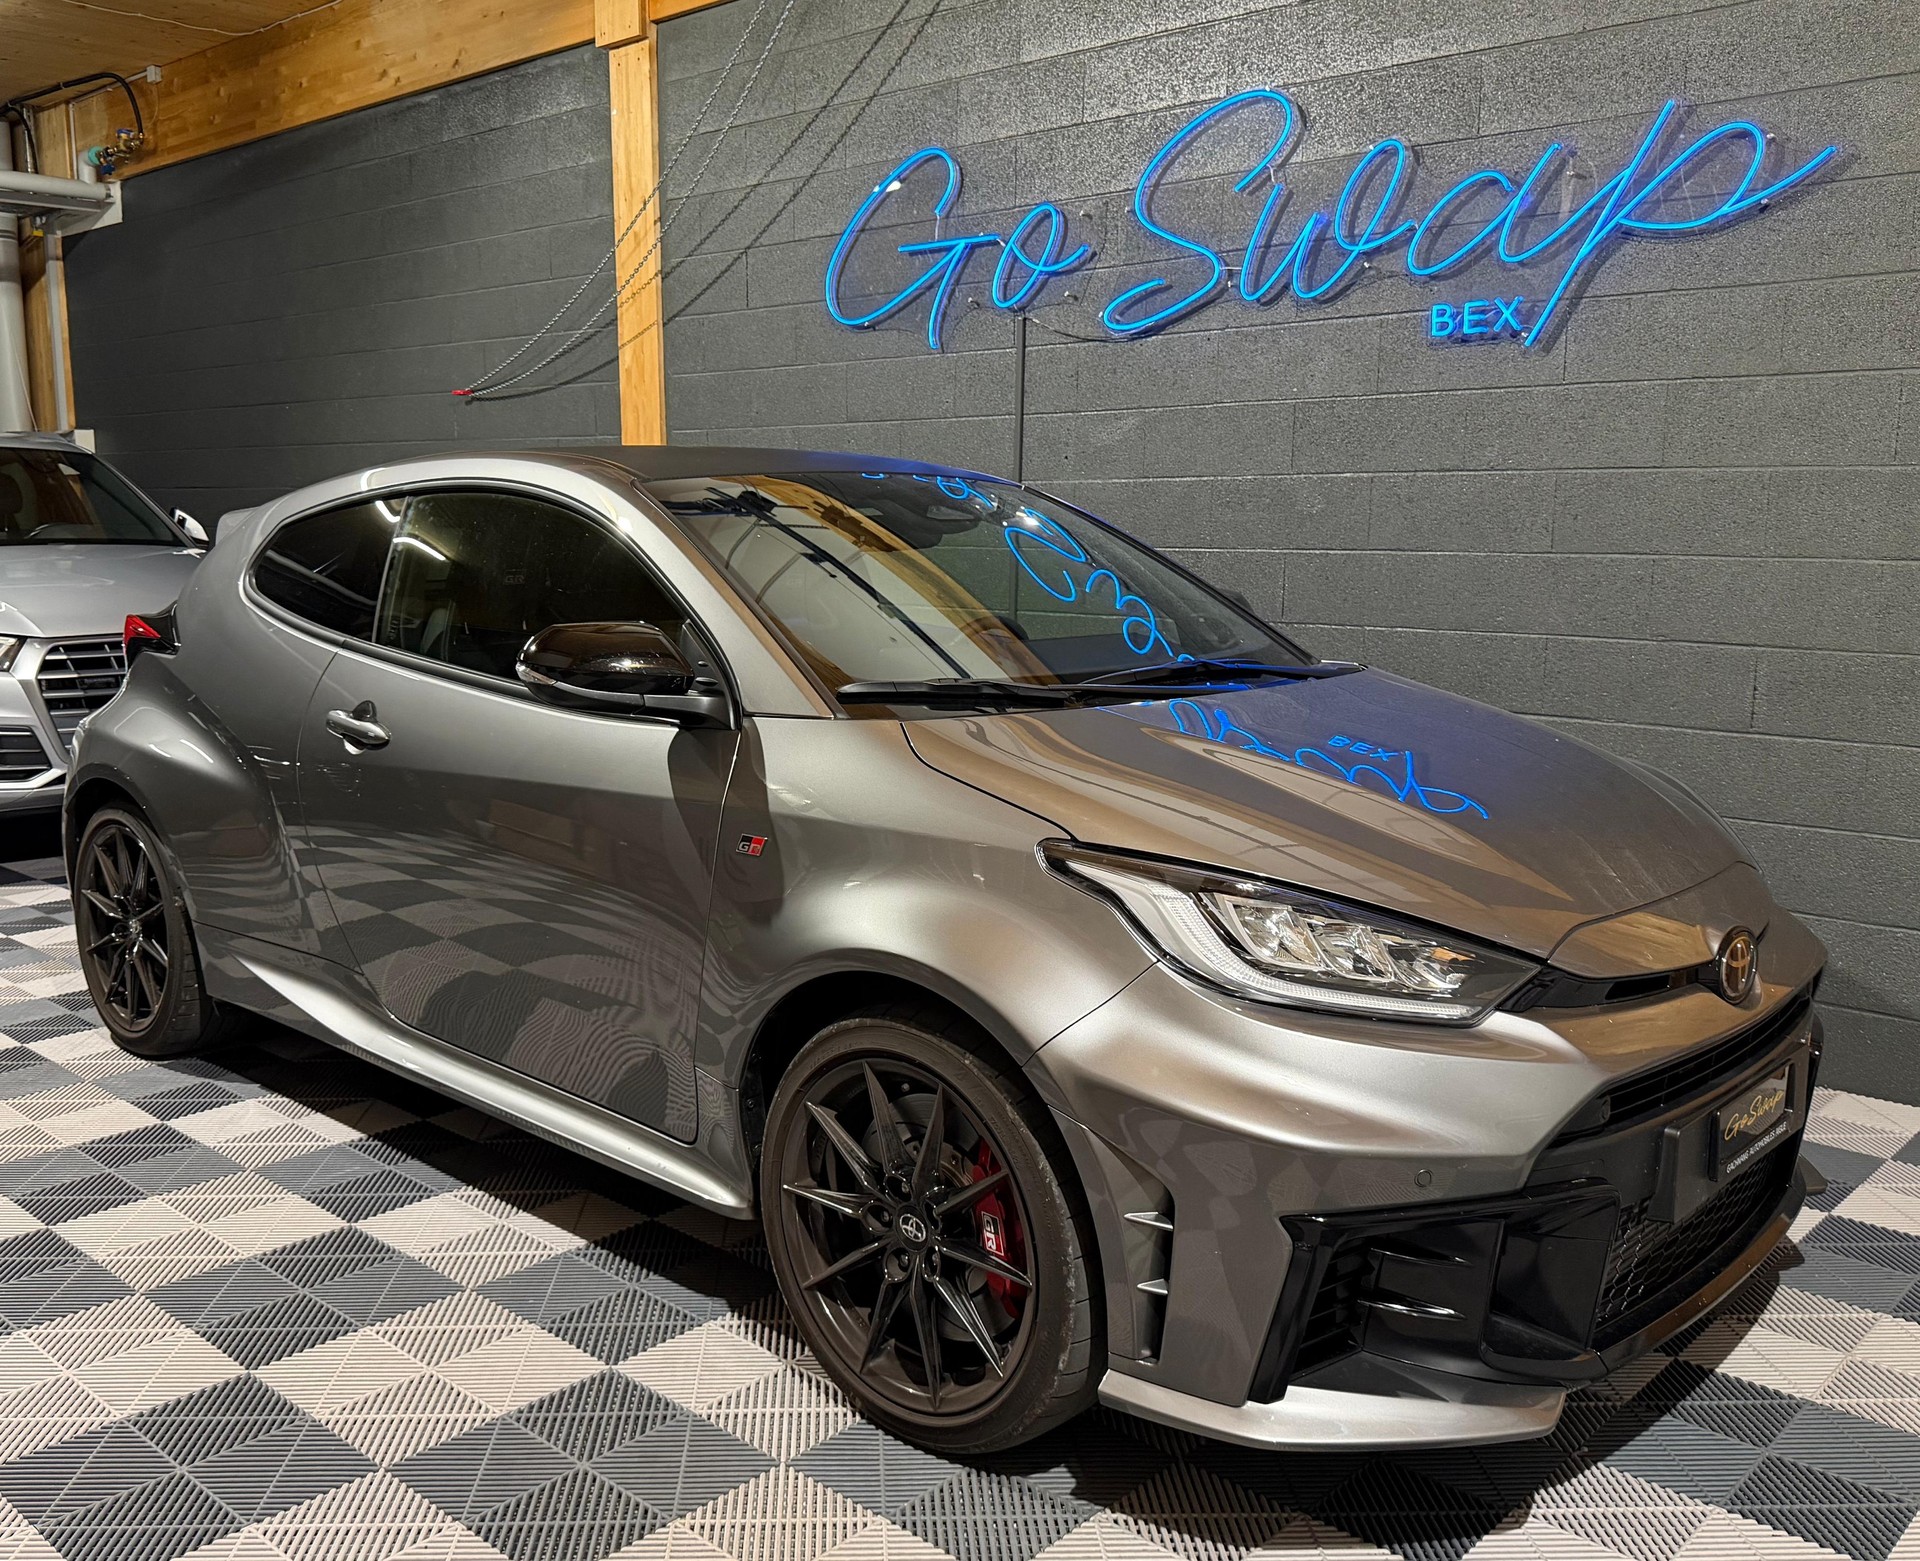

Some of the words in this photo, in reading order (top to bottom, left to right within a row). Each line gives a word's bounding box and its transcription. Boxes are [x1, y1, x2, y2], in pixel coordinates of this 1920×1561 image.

[825, 145, 1090, 350] Go
[1102, 88, 1838, 348] Swap
[1430, 295, 1525, 338] BEX
[983, 1213, 997, 1251] GR
